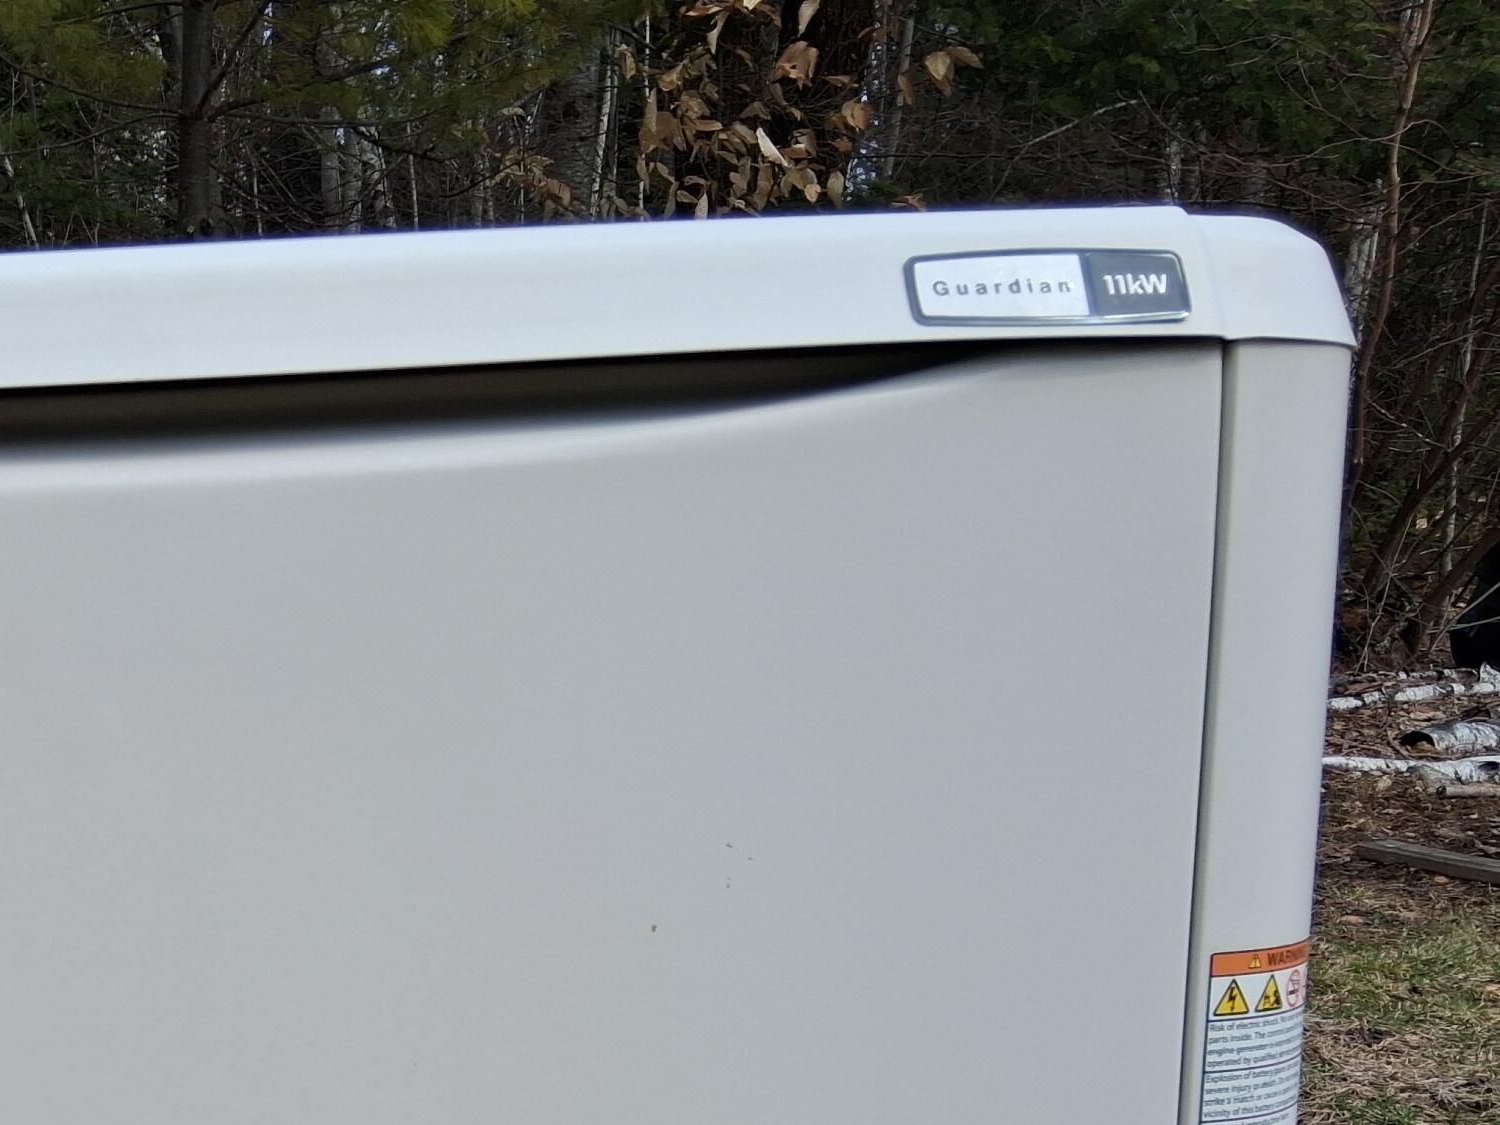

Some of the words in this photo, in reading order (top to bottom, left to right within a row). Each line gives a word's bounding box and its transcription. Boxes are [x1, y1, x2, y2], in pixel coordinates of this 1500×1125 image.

[932, 278, 1072, 297] Guardian
[1102, 273, 1168, 296] 11kW
[1227, 1021, 1235, 1031] of
[1209, 1036, 1229, 1045] parts
[1255, 1031, 1266, 1039] The
[1208, 1047, 1235, 1058] engine
[1206, 1058, 1240, 1069] operated
[1243, 1056, 1252, 1066] by
[1206, 1073, 1243, 1084] Explosion
[1244, 1071, 1252, 1080] of
[1205, 1087, 1230, 1095] severe
[1204, 1097, 1225, 1107] strike
[1204, 1110, 1231, 1119] vicinity
[1232, 1108, 1241, 1116] of
